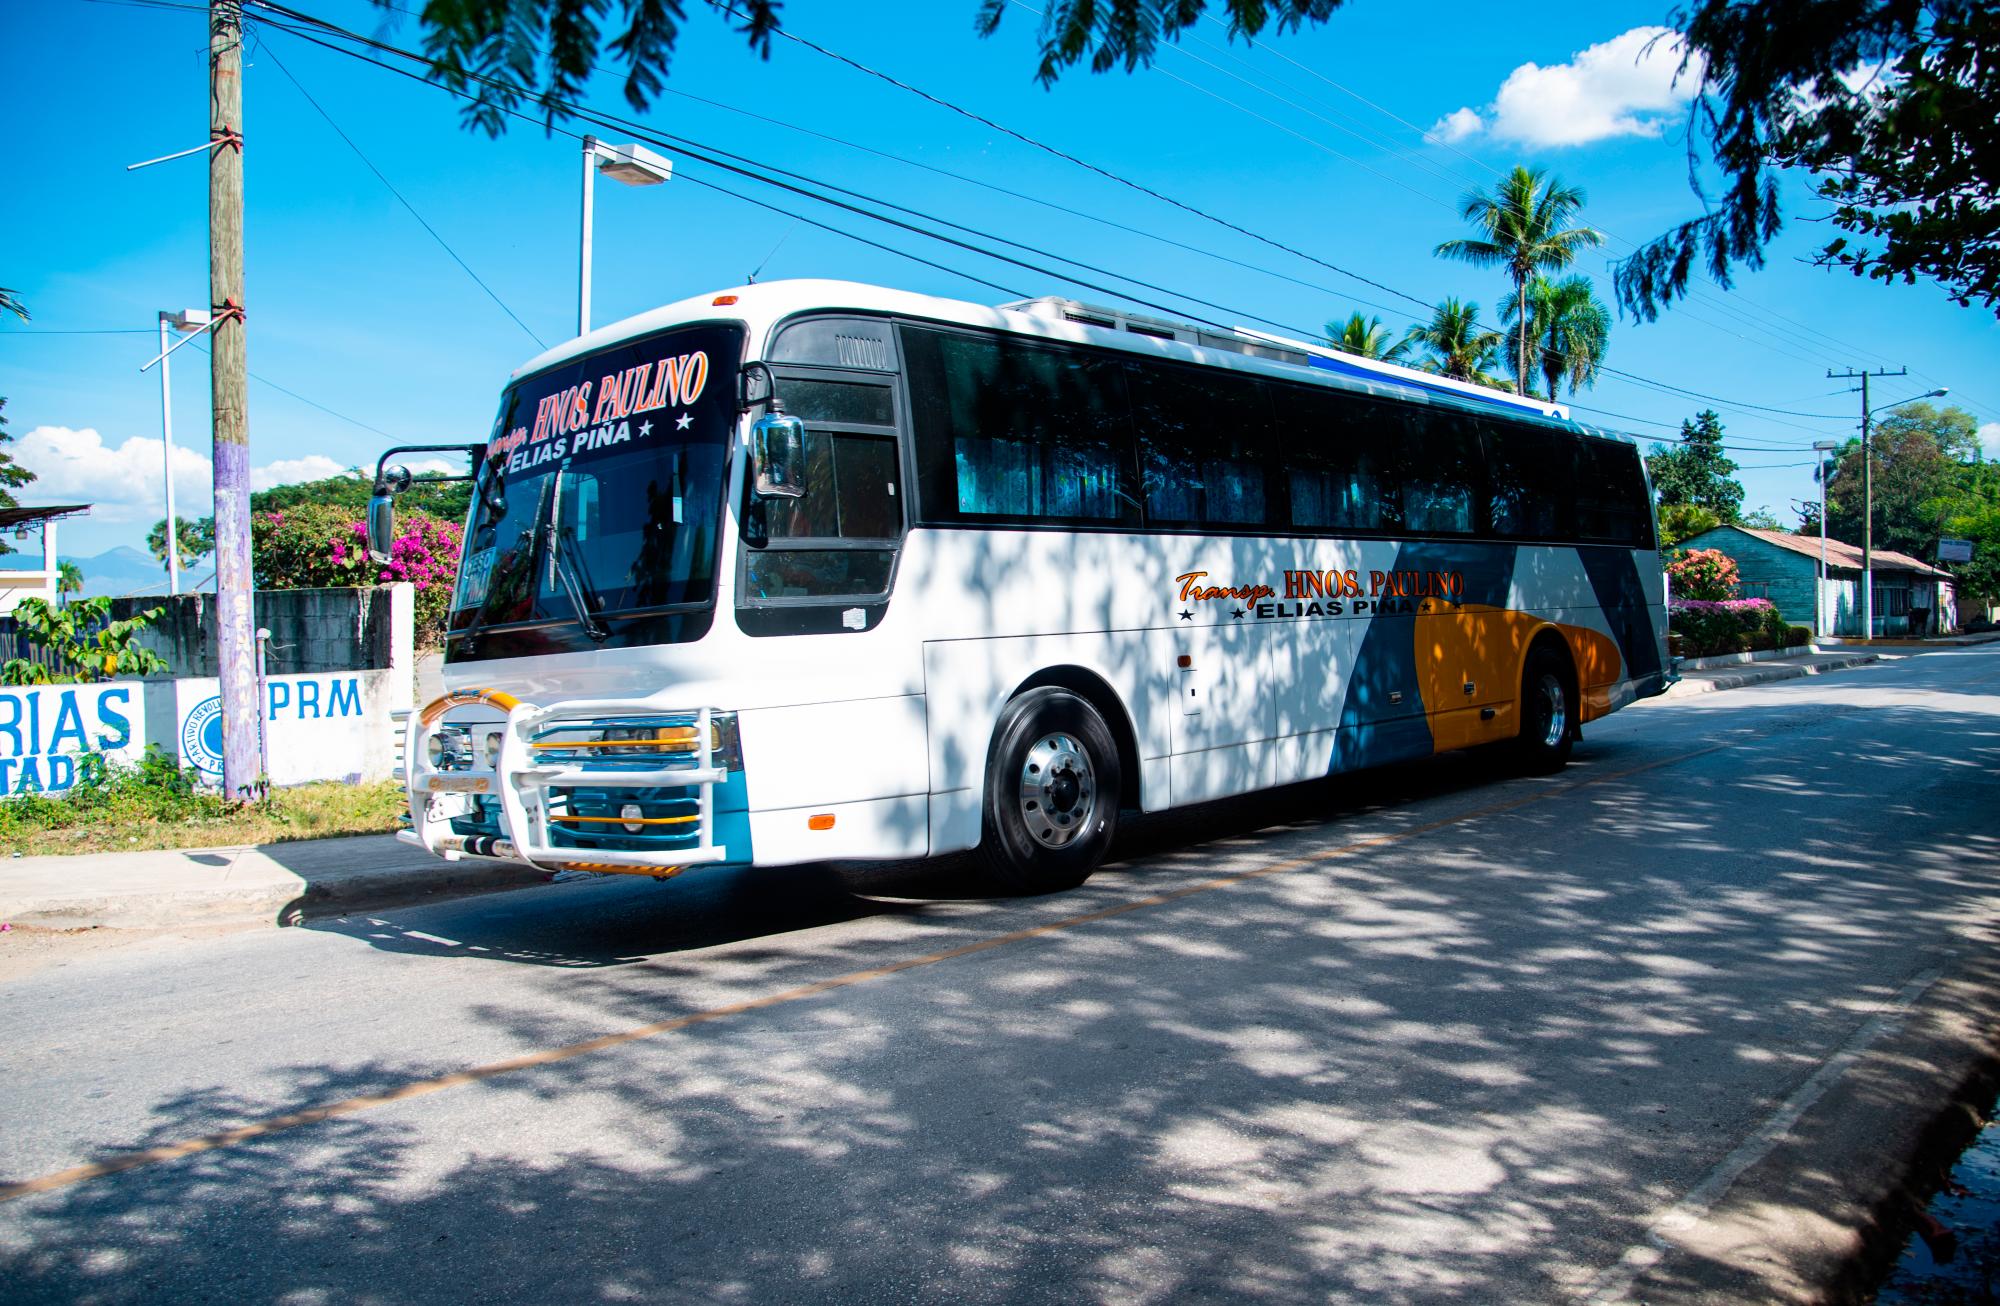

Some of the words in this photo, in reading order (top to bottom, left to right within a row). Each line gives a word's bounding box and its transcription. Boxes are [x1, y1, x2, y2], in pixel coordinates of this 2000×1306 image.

[591, 351, 708, 425] PAULINO
[509, 438, 568, 473] ELIAS
[572, 421, 631, 454] PIÑA
[1176, 571, 1275, 610] Transp.
[1284, 570, 1364, 598] HNOS.
[1370, 570, 1464, 597] PAULINO
[1257, 601, 1343, 619] ELIAS
[268, 679, 362, 720] PRM
[0, 688, 130, 757] RIAS
[209, 760, 224, 771] PR
